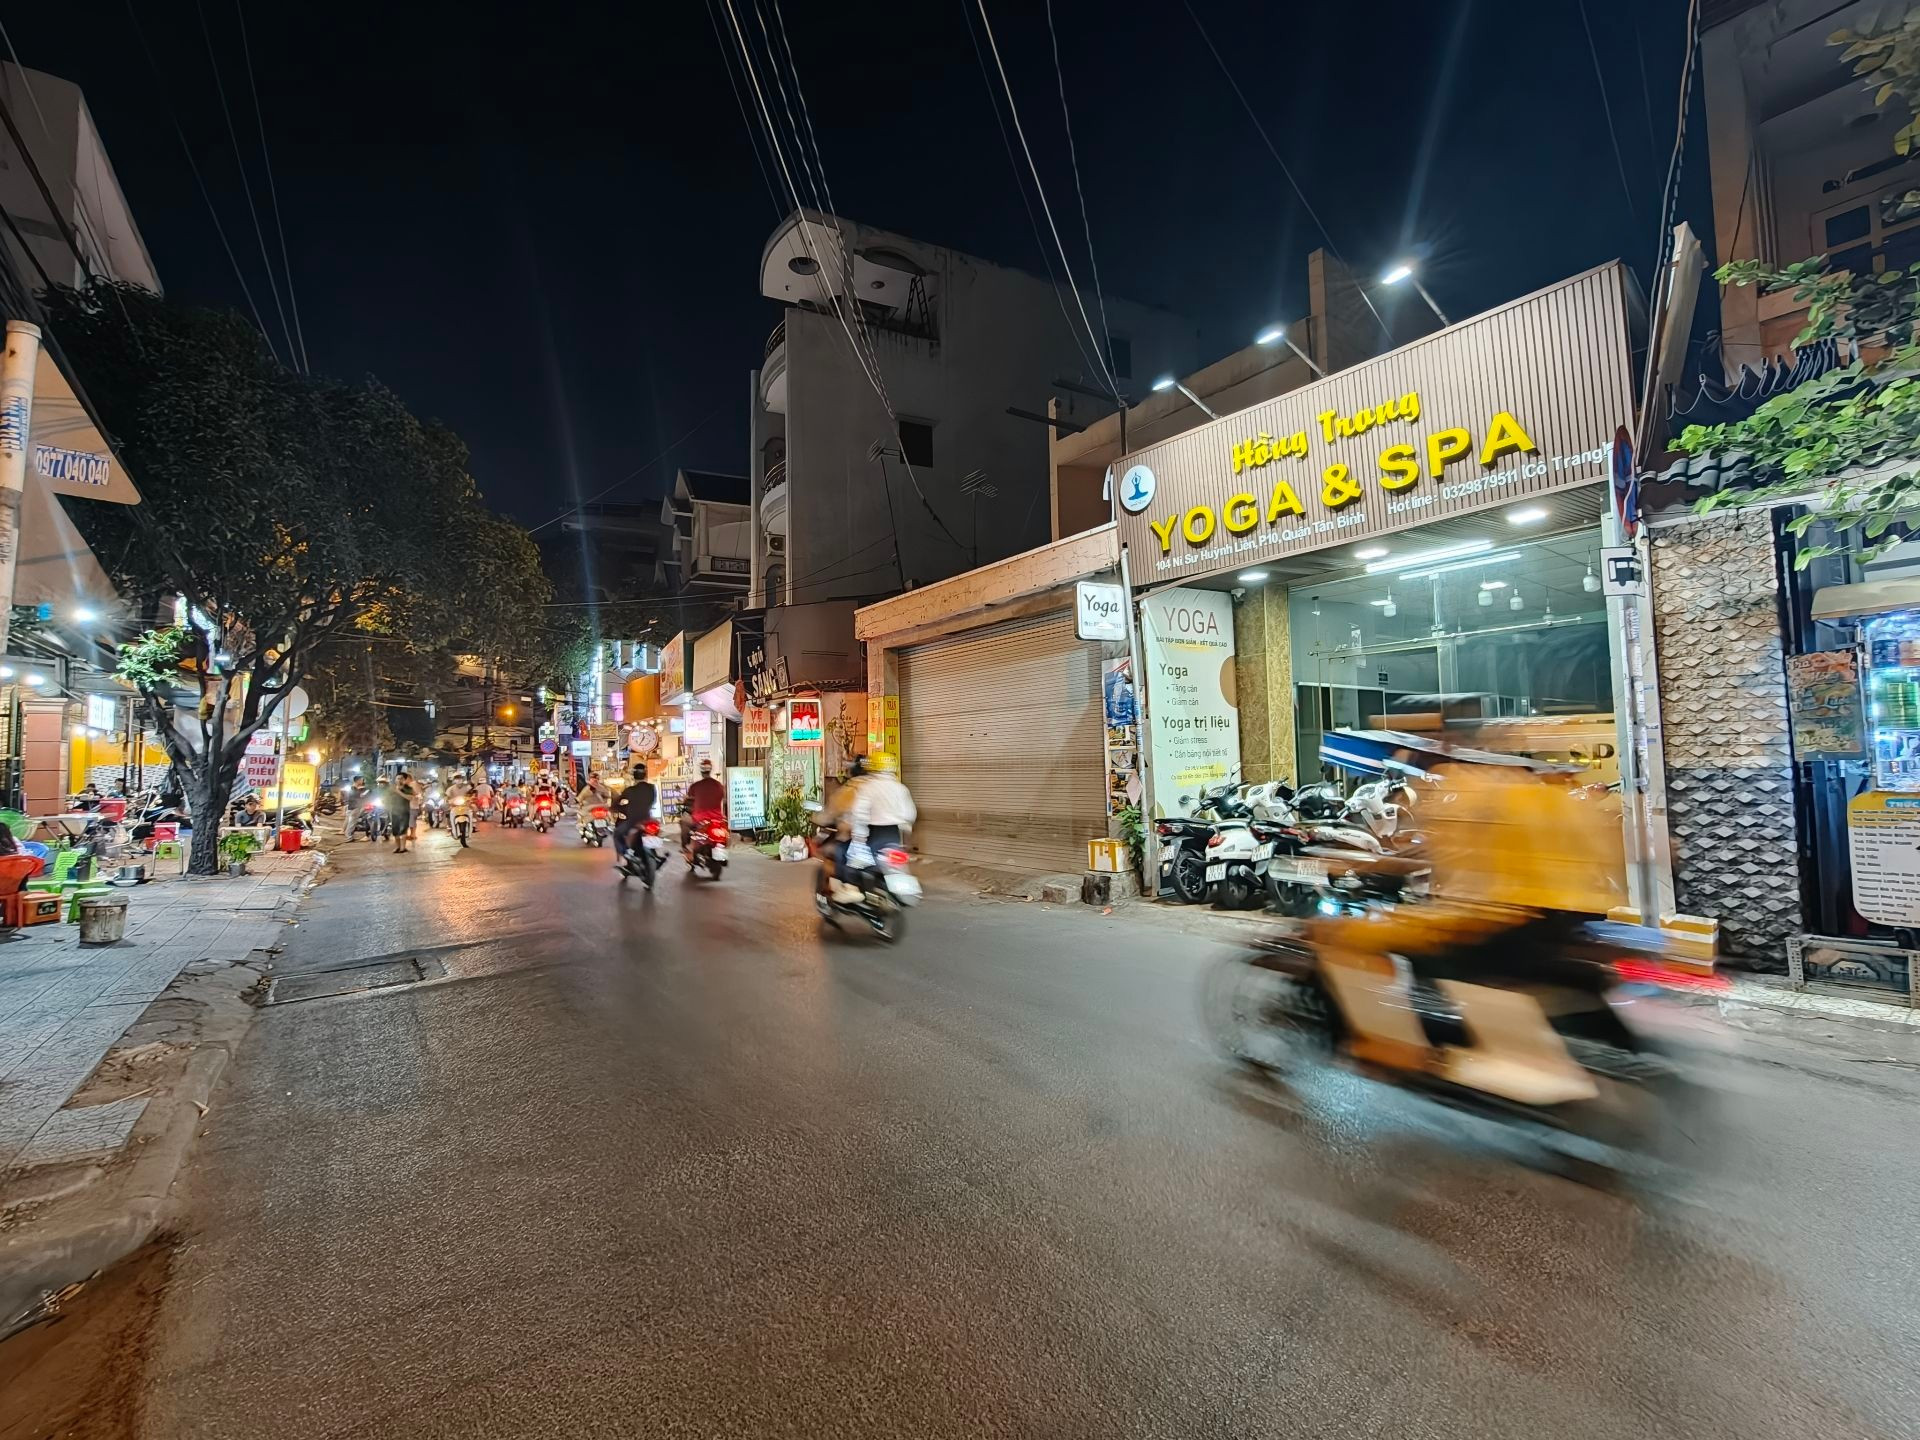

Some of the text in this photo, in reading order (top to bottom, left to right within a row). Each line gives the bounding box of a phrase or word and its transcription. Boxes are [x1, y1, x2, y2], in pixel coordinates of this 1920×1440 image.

[1232, 391, 1421, 474] Hồng Trang
[1150, 410, 1539, 552] YOGA & SPA
[1387, 493, 1438, 515] Hotline:
[1442, 469, 1518, 500] 0329879511
[1156, 559, 1171, 571] 104
[1312, 519, 1334, 534] Tân
[1084, 594, 1120, 618] Yoga
[1162, 606, 1219, 636] YOGA
[1159, 662, 1189, 680] Yoga
[1162, 715, 1230, 732] Yoga trị liệu
[248, 778, 272, 787] CUA
